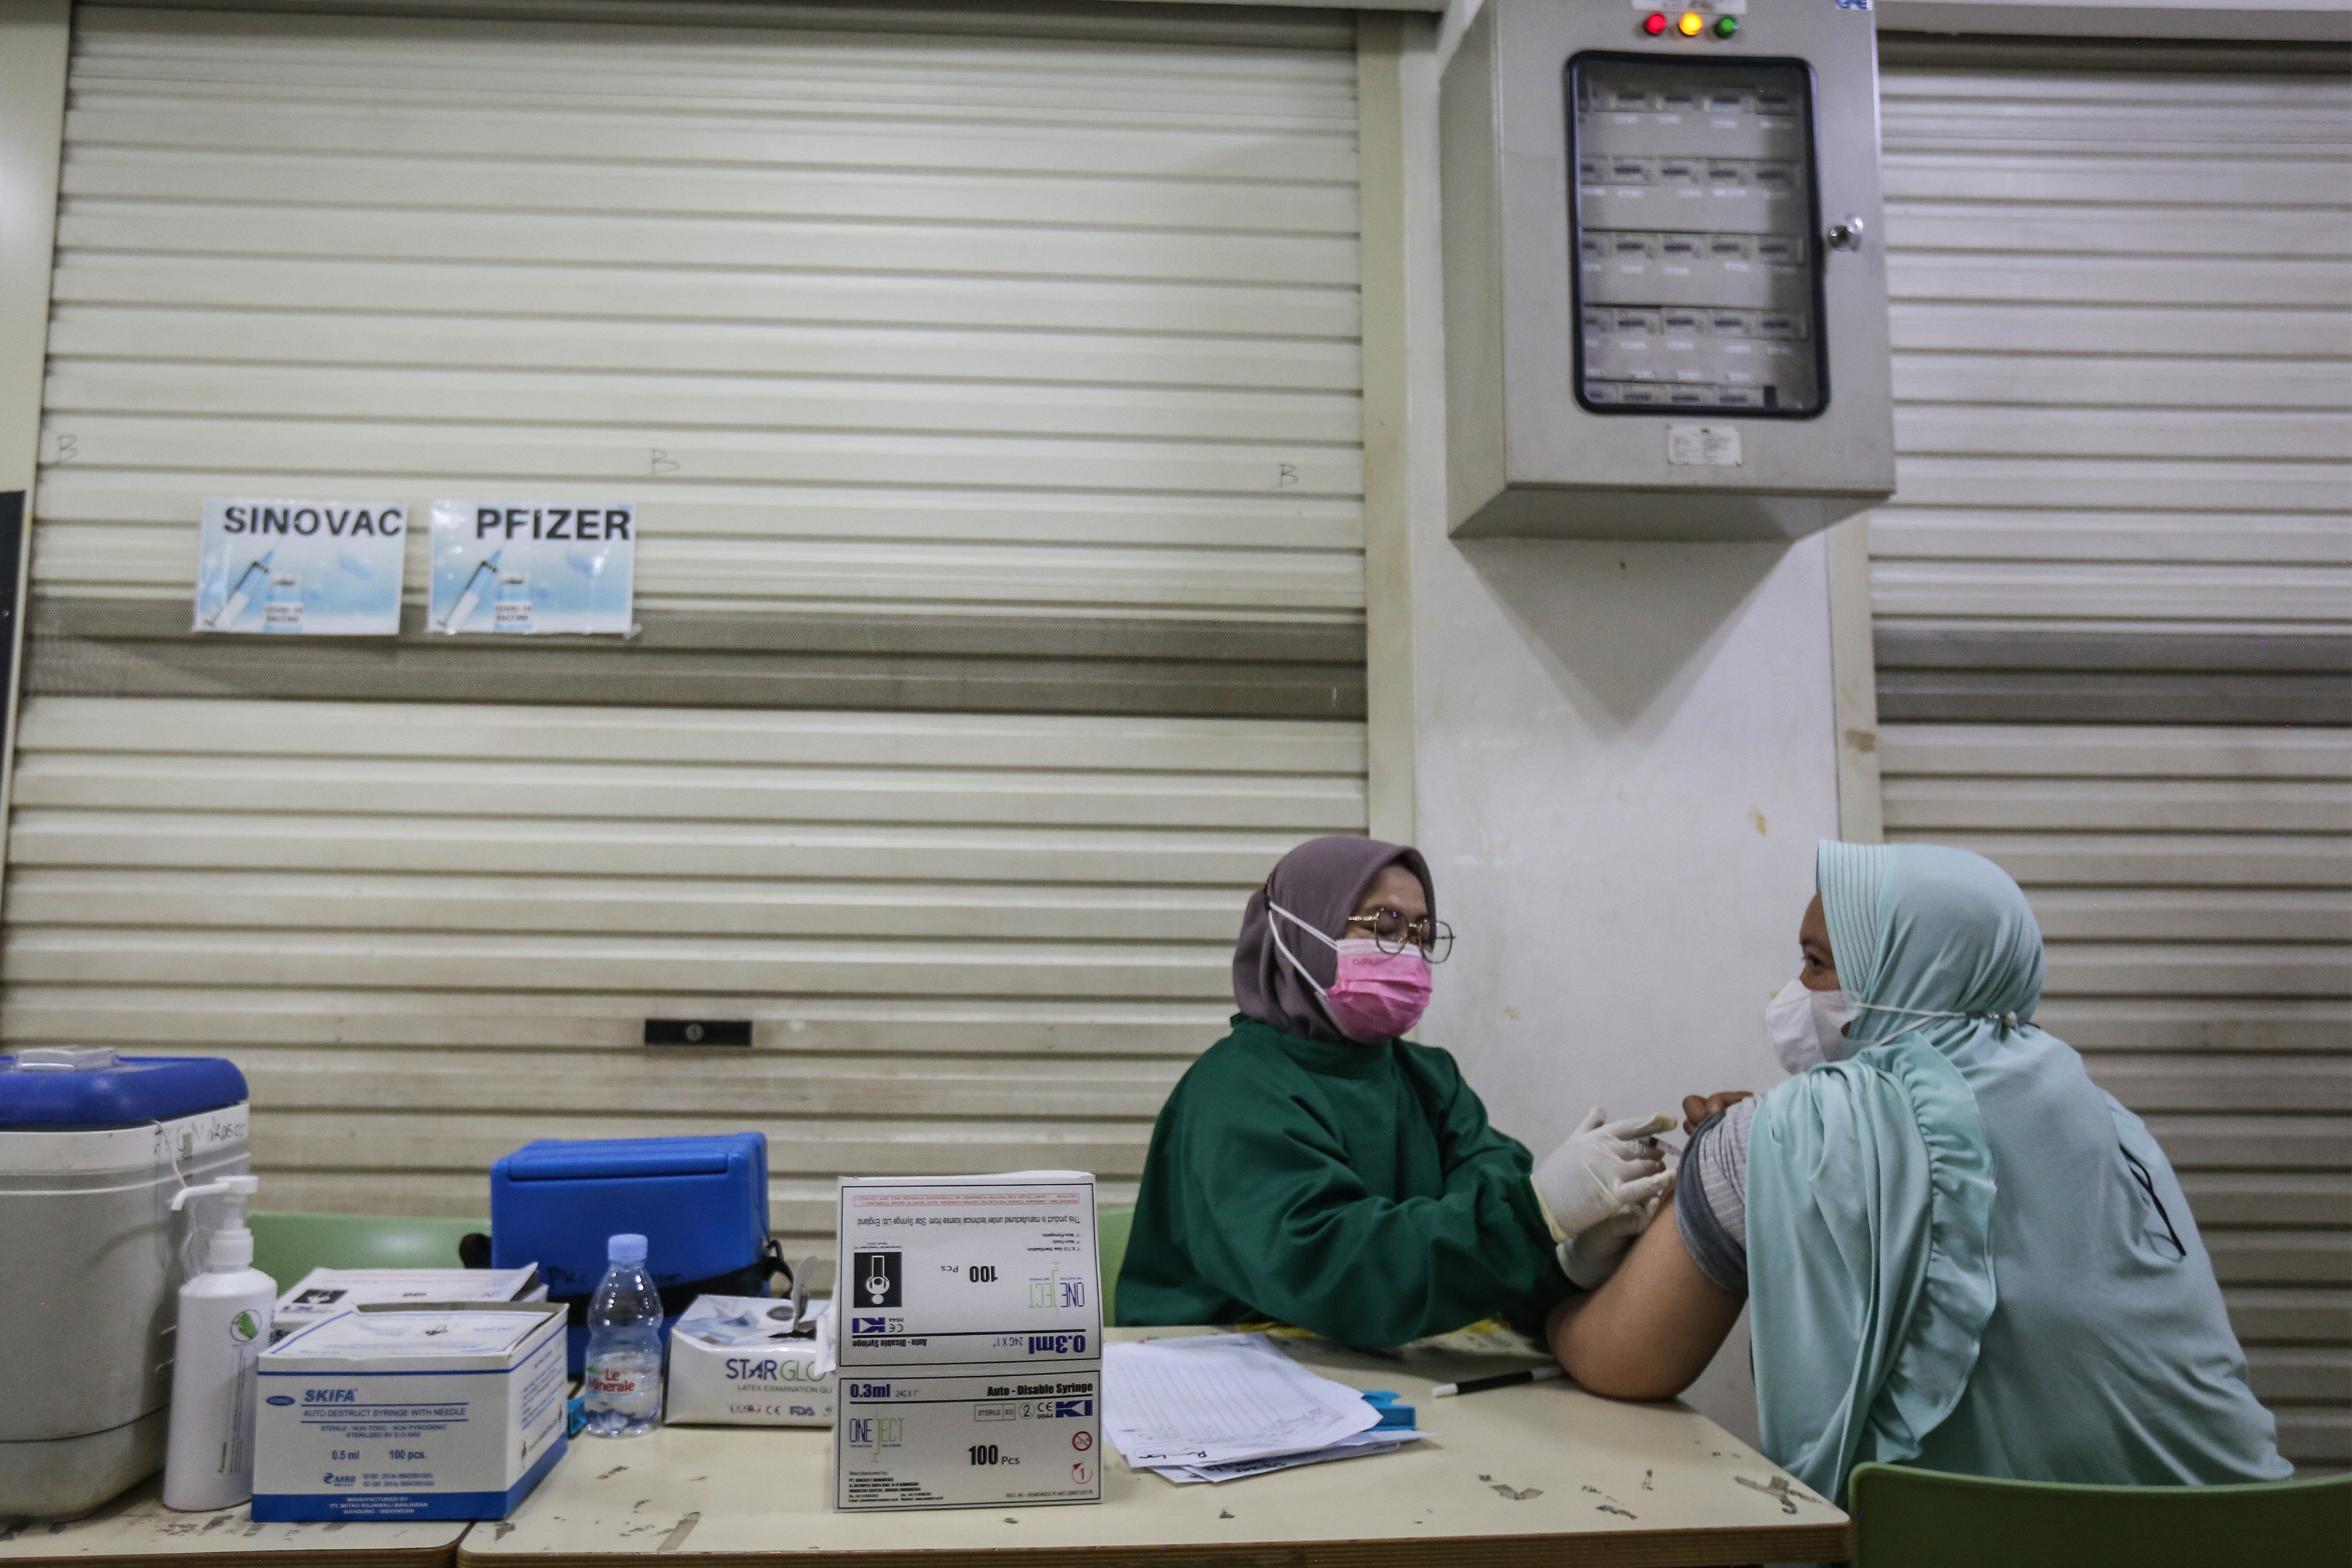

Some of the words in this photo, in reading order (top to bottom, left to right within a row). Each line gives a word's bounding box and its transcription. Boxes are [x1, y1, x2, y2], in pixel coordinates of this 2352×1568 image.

[1279, 464, 1299, 487] B
[224, 508, 402, 536] SINOVAC
[477, 509, 631, 540] PFIZER
[858, 1217, 880, 1226] England
[894, 1216, 914, 1226] Syringe
[916, 1218, 927, 1226] Star
[1005, 1216, 1041, 1225] manufactured
[1048, 1215, 1067, 1223] product
[970, 1266, 998, 1283] 100
[1060, 1282, 1085, 1308] ONE
[889, 1323, 904, 1333] CE
[853, 1339, 879, 1348] Syringe
[881, 1339, 906, 1348] Disable
[1003, 1338, 1008, 1346] X
[1010, 1336, 1023, 1346] 24G
[1029, 1335, 1086, 1355] 0.3ml
[605, 1368, 620, 1381] Le
[726, 1359, 777, 1380] STAR
[305, 1389, 356, 1402] SKIFA
[850, 1383, 891, 1398] 0.3ml
[988, 1386, 1009, 1396] Auto
[1017, 1384, 1054, 1395] Disable
[1056, 1383, 1093, 1394] Syringe
[790, 1406, 816, 1416] FDA
[1024, 1404, 1030, 1417] 2
[1037, 1402, 1053, 1412] CE
[850, 1417, 873, 1443] ONE
[332, 1450, 346, 1459] 0.5
[348, 1450, 360, 1459] ml
[389, 1450, 405, 1459] 100
[408, 1452, 427, 1461] pcs.
[968, 1445, 999, 1465] 100
[1001, 1456, 1020, 1465] Pcs
[1080, 1467, 1084, 1480] 1
